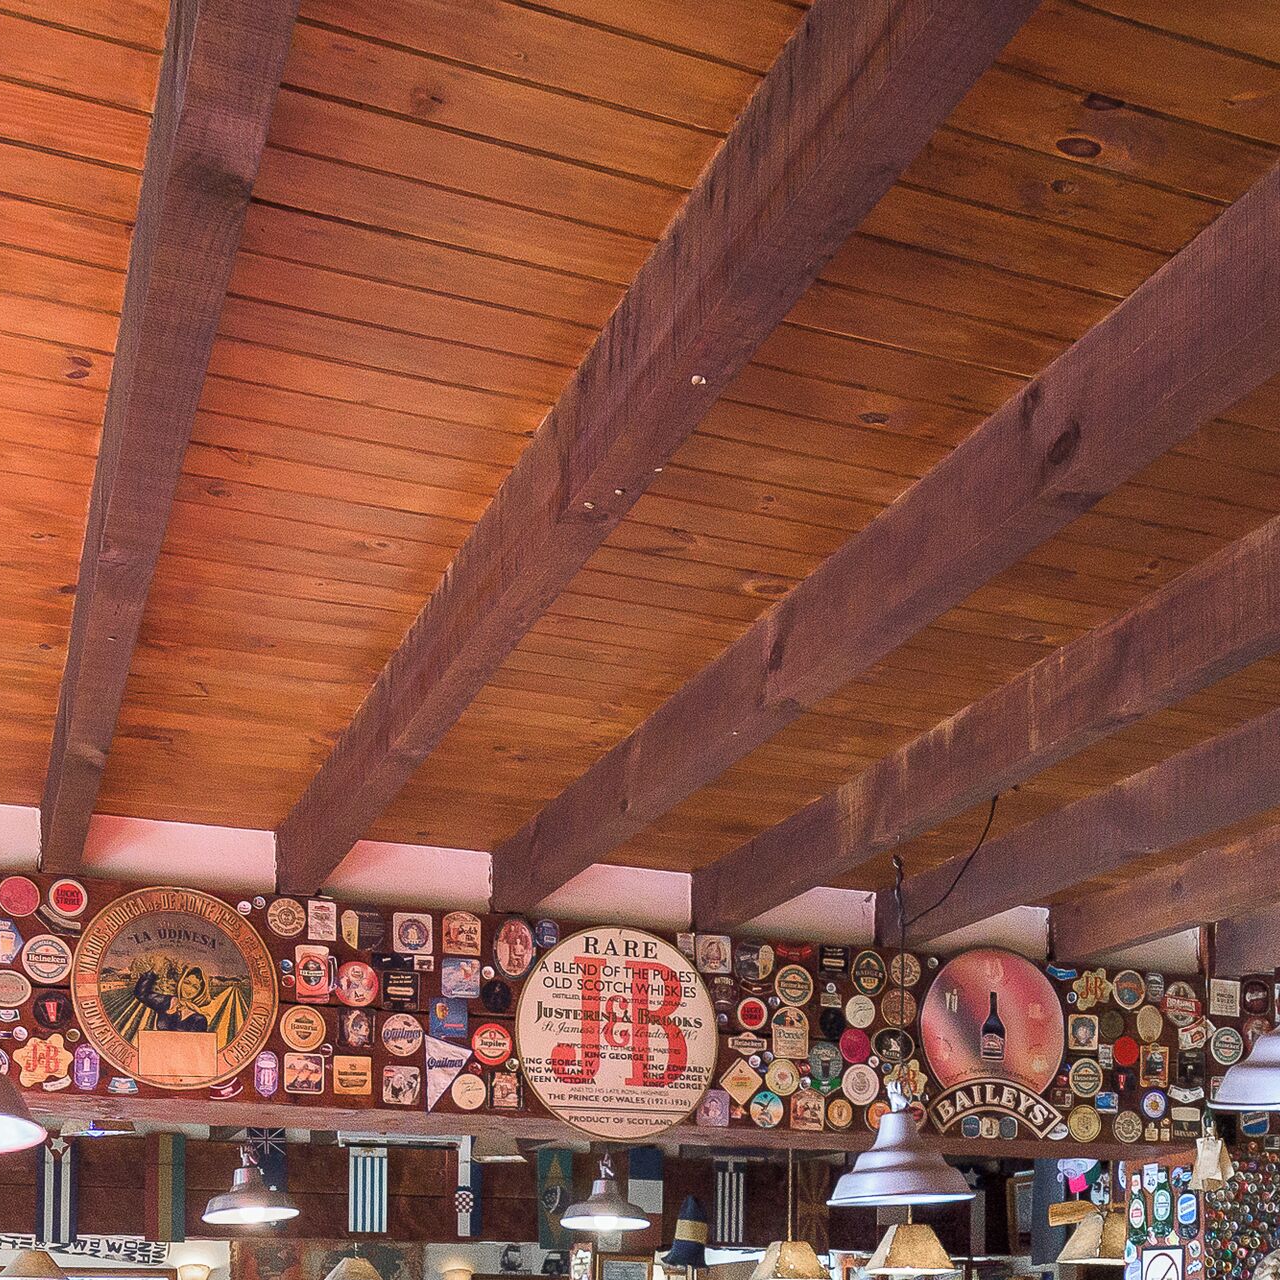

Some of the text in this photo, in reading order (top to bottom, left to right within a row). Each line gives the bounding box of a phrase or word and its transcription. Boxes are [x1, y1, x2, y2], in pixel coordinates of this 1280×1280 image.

[56, 889, 81, 898] LUCKY
[107, 897, 147, 931] BODEGA
[583, 936, 658, 960] RARE
[27, 953, 67, 964] Heineken
[539, 961, 549, 972] A
[553, 962, 597, 976] BLEND
[602, 965, 620, 977] OF
[623, 967, 649, 980] THE
[653, 969, 698, 983] PUREST
[543, 976, 696, 998] OLD SCOTCH WHISKIES
[535, 1001, 703, 1029] JUSTERINI & BROOKS
[81, 1001, 114, 1047] BOWEN
[480, 1040, 507, 1050] Jupiler
[584, 1051, 606, 1059] KING
[609, 1052, 643, 1061] GEORGE
[427, 1056, 464, 1070] Quilmes
[545, 1058, 582, 1067] GEORGE
[643, 1063, 665, 1071] KING
[667, 1064, 704, 1073] EDWARD
[553, 1076, 597, 1085] VICTORIA
[667, 1073, 702, 1081] GEORGE
[667, 1082, 702, 1090] GEORGE
[548, 1093, 565, 1101] THE
[568, 1094, 600, 1102] PRINCE
[602, 1095, 615, 1103] OF
[615, 1096, 645, 1104] WALES
[936, 1084, 1049, 1126] BAILEYS
[568, 1115, 673, 1127] PRODUCT OF SCOTLAND
